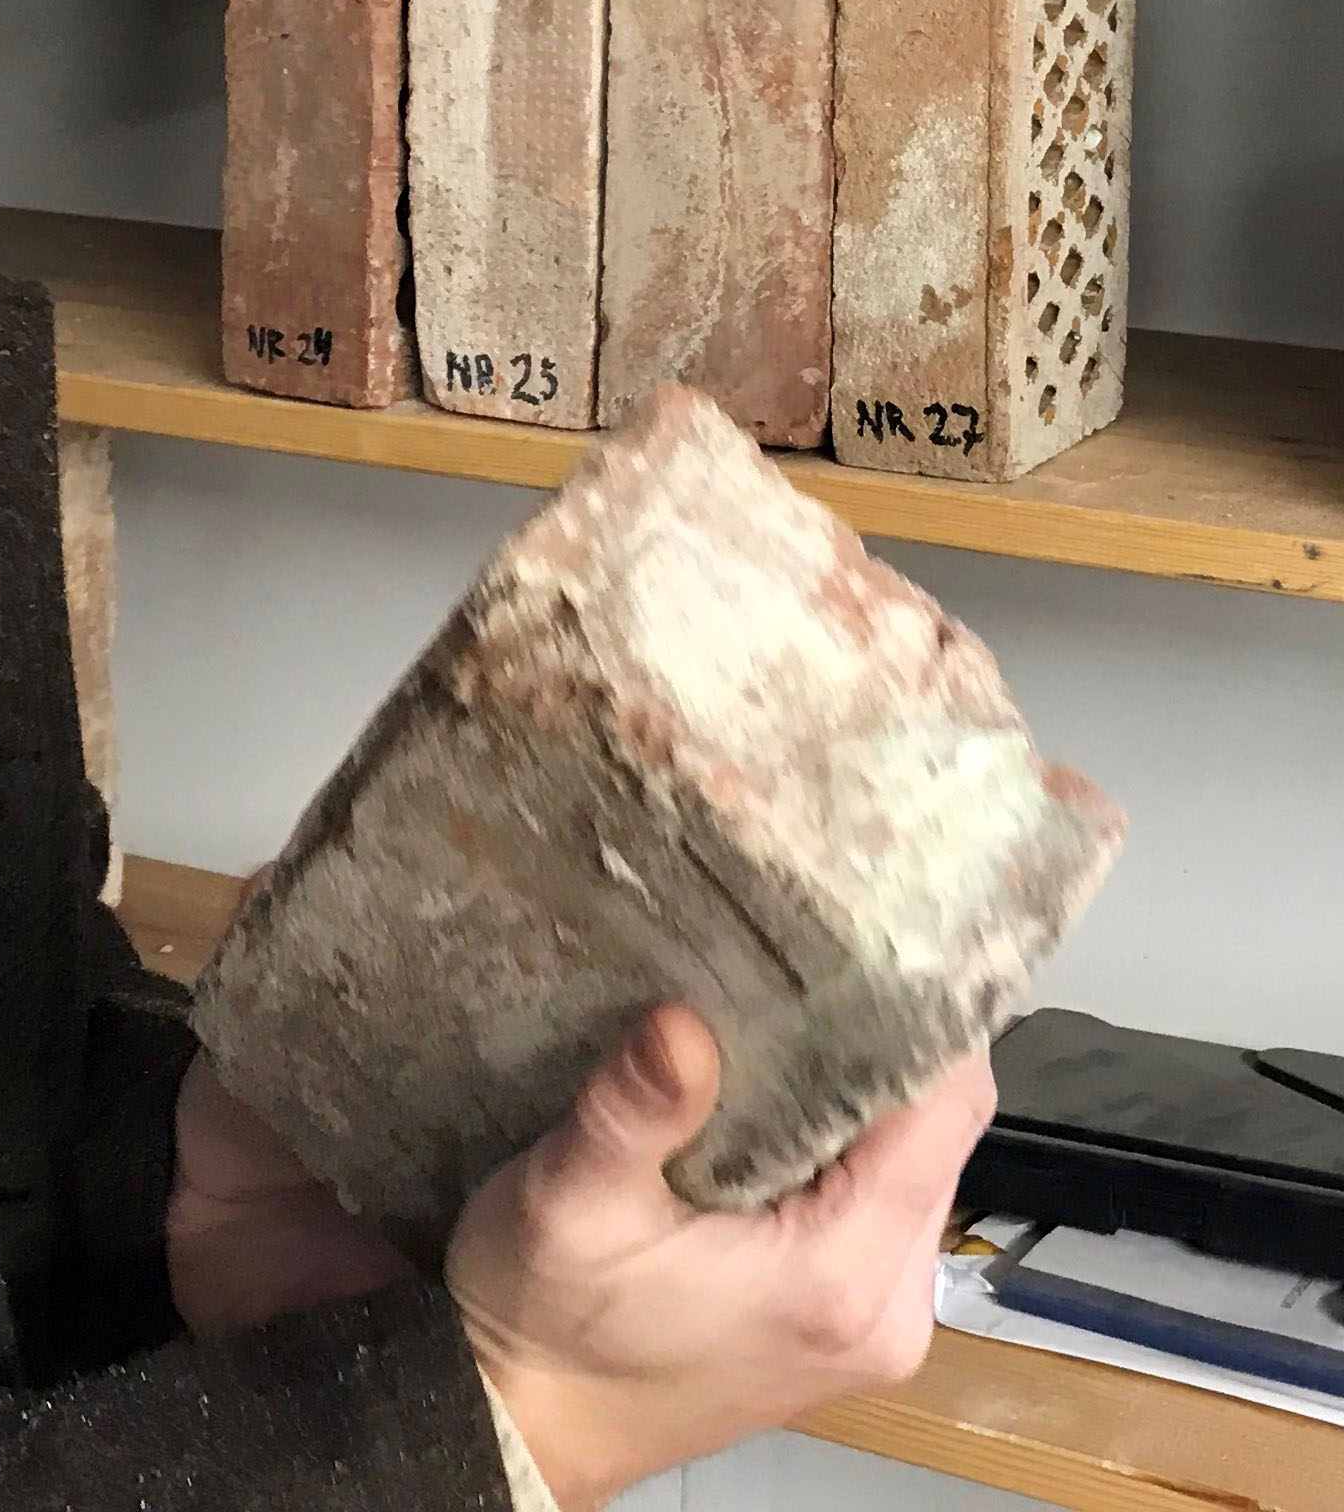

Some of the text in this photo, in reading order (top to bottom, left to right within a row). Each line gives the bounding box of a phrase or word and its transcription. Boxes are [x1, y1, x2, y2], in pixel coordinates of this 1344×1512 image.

[247, 324, 287, 365] NR
[445, 349, 559, 406] NR 25
[856, 399, 986, 457] NR 27
